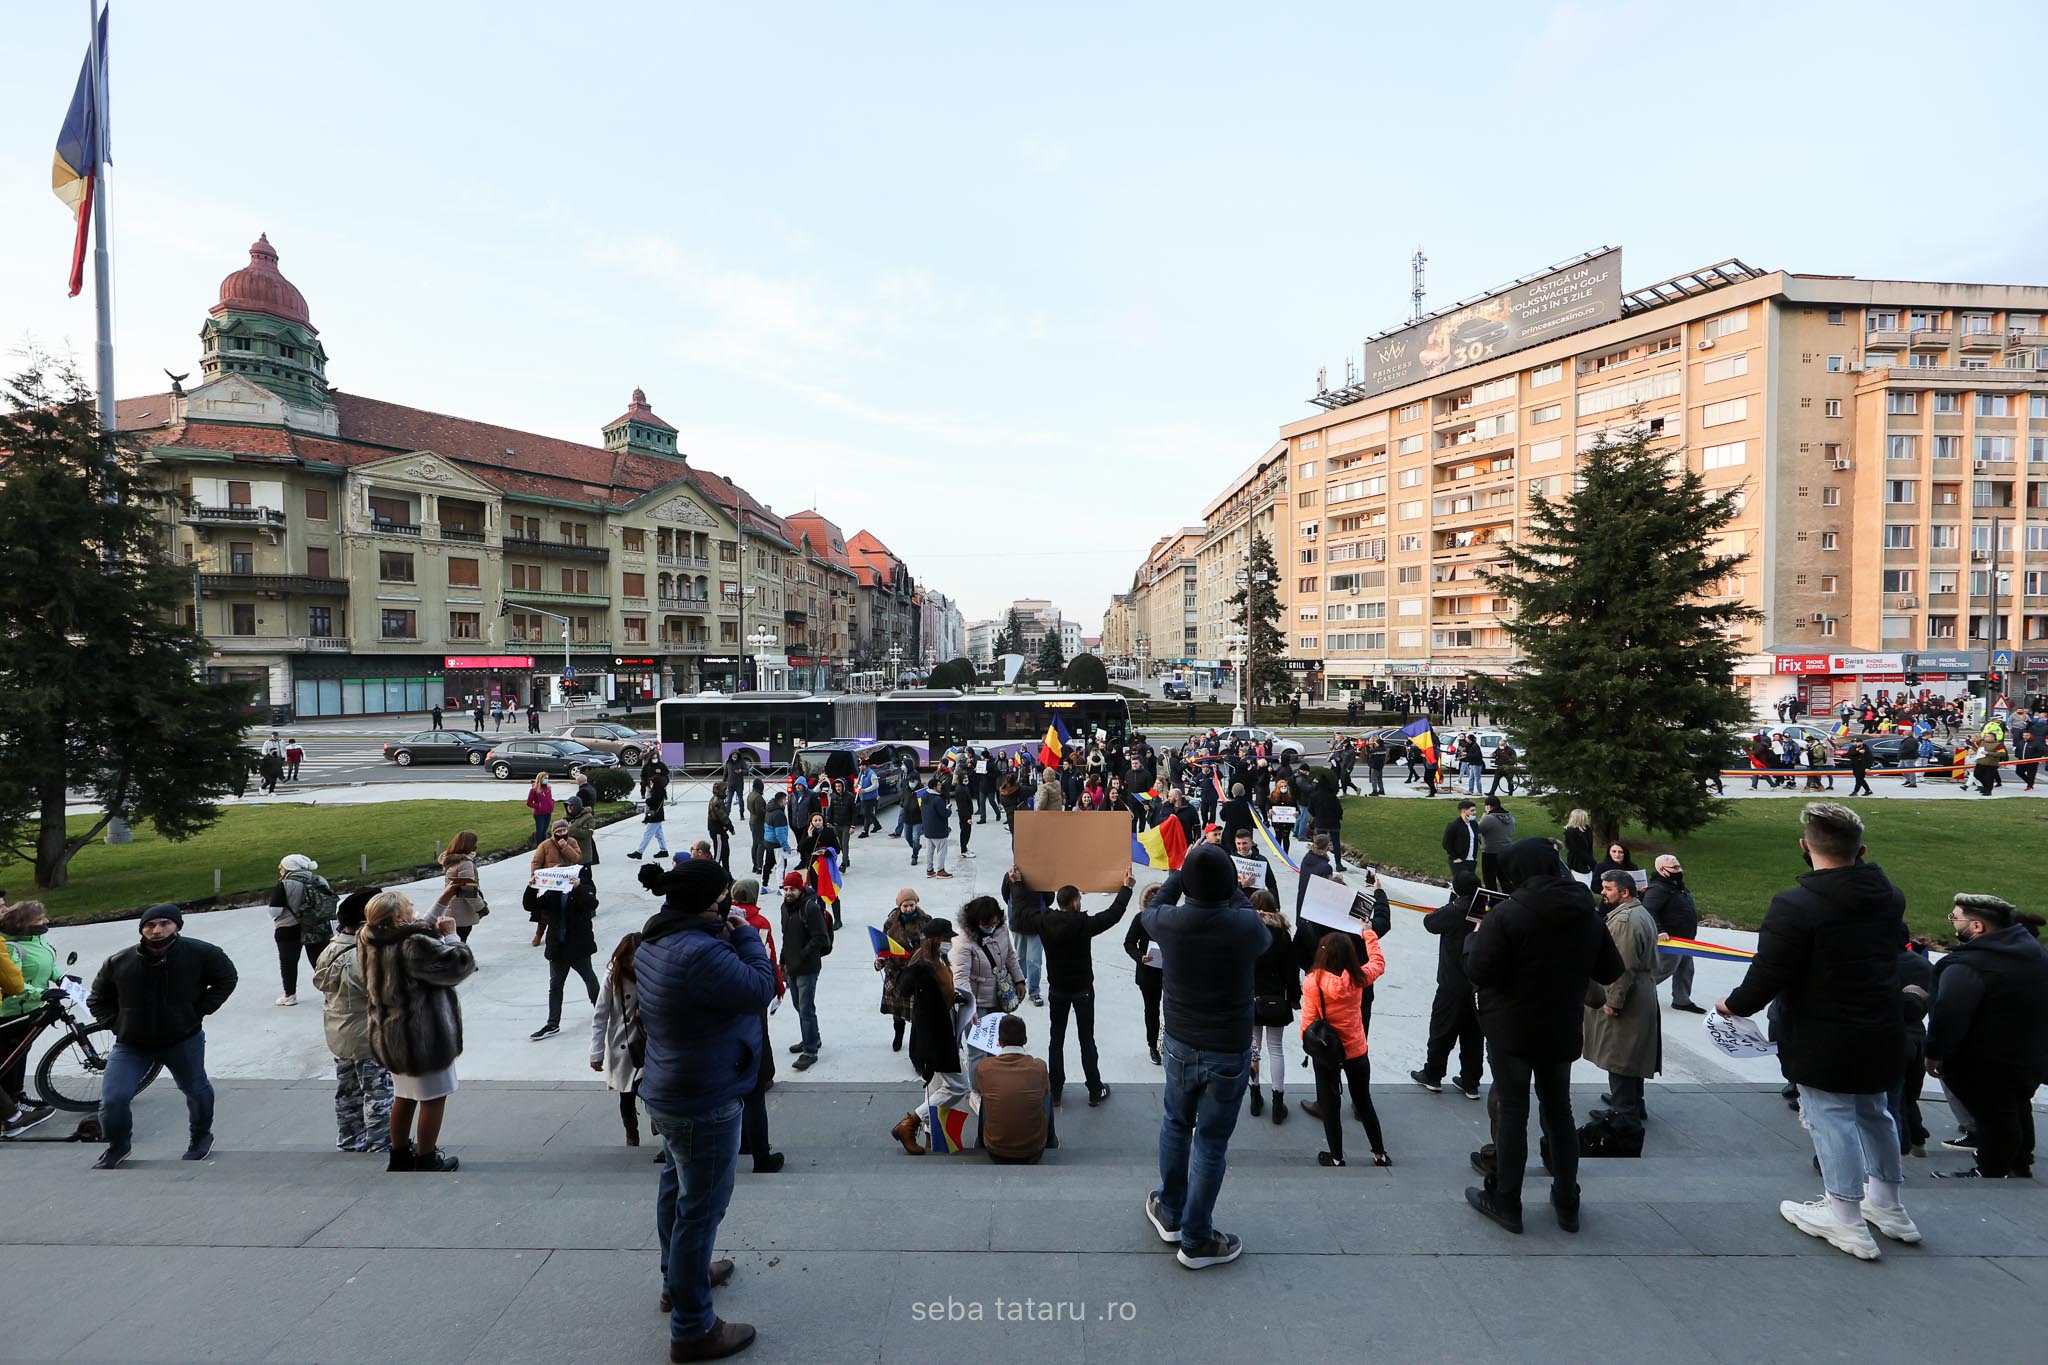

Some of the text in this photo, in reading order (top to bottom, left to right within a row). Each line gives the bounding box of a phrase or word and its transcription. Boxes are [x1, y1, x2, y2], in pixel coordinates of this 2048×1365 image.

[1573, 268, 1589, 281] UN
[1509, 271, 1609, 313] VOLKSWAGEN GOLF
[1522, 306, 1540, 319] DIN
[1541, 304, 1548, 313] 3
[1562, 296, 1569, 305] 3
[1570, 287, 1593, 302] ZILE
[1521, 307, 1595, 337] princesscasino.ro
[1372, 360, 1412, 379] PRINCESS
[1376, 369, 1408, 384] CASINO
[1778, 658, 1802, 672] iFix
